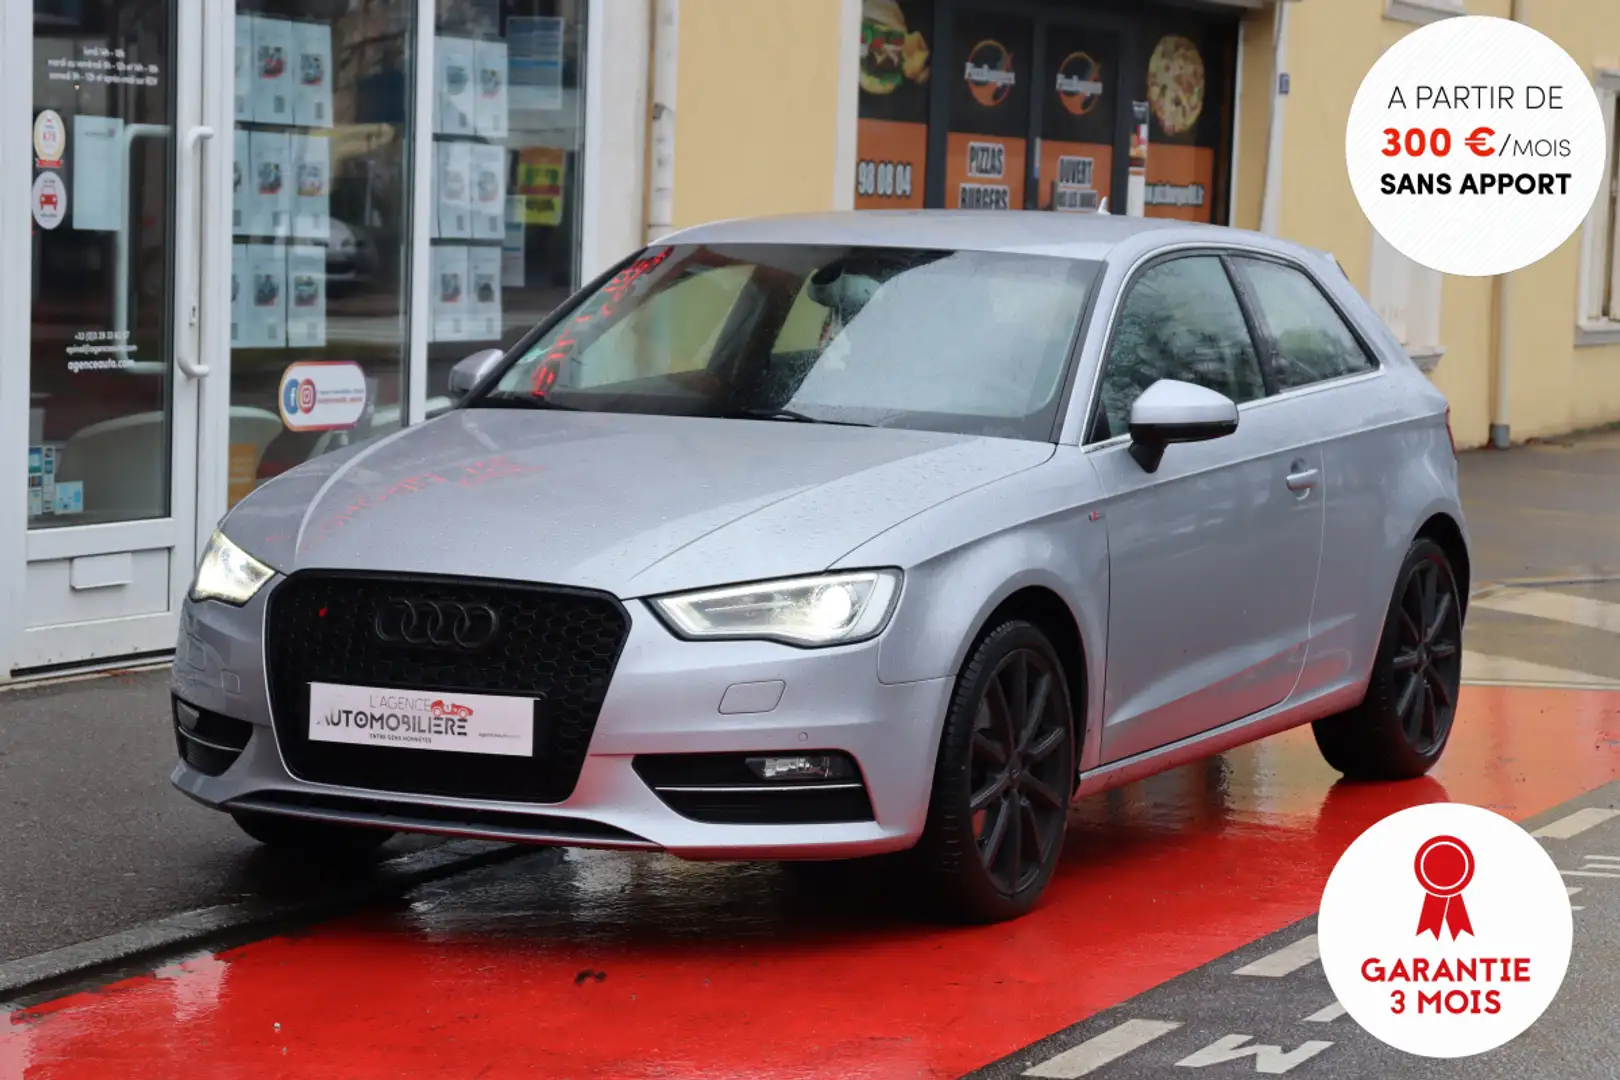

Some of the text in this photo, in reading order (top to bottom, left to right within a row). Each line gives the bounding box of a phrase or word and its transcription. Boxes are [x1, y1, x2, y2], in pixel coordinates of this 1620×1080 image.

[969, 145, 1003, 176] PIZZAS
[960, 186, 1009, 210] BURGERS
[369, 694, 432, 712] L'AGENCE
